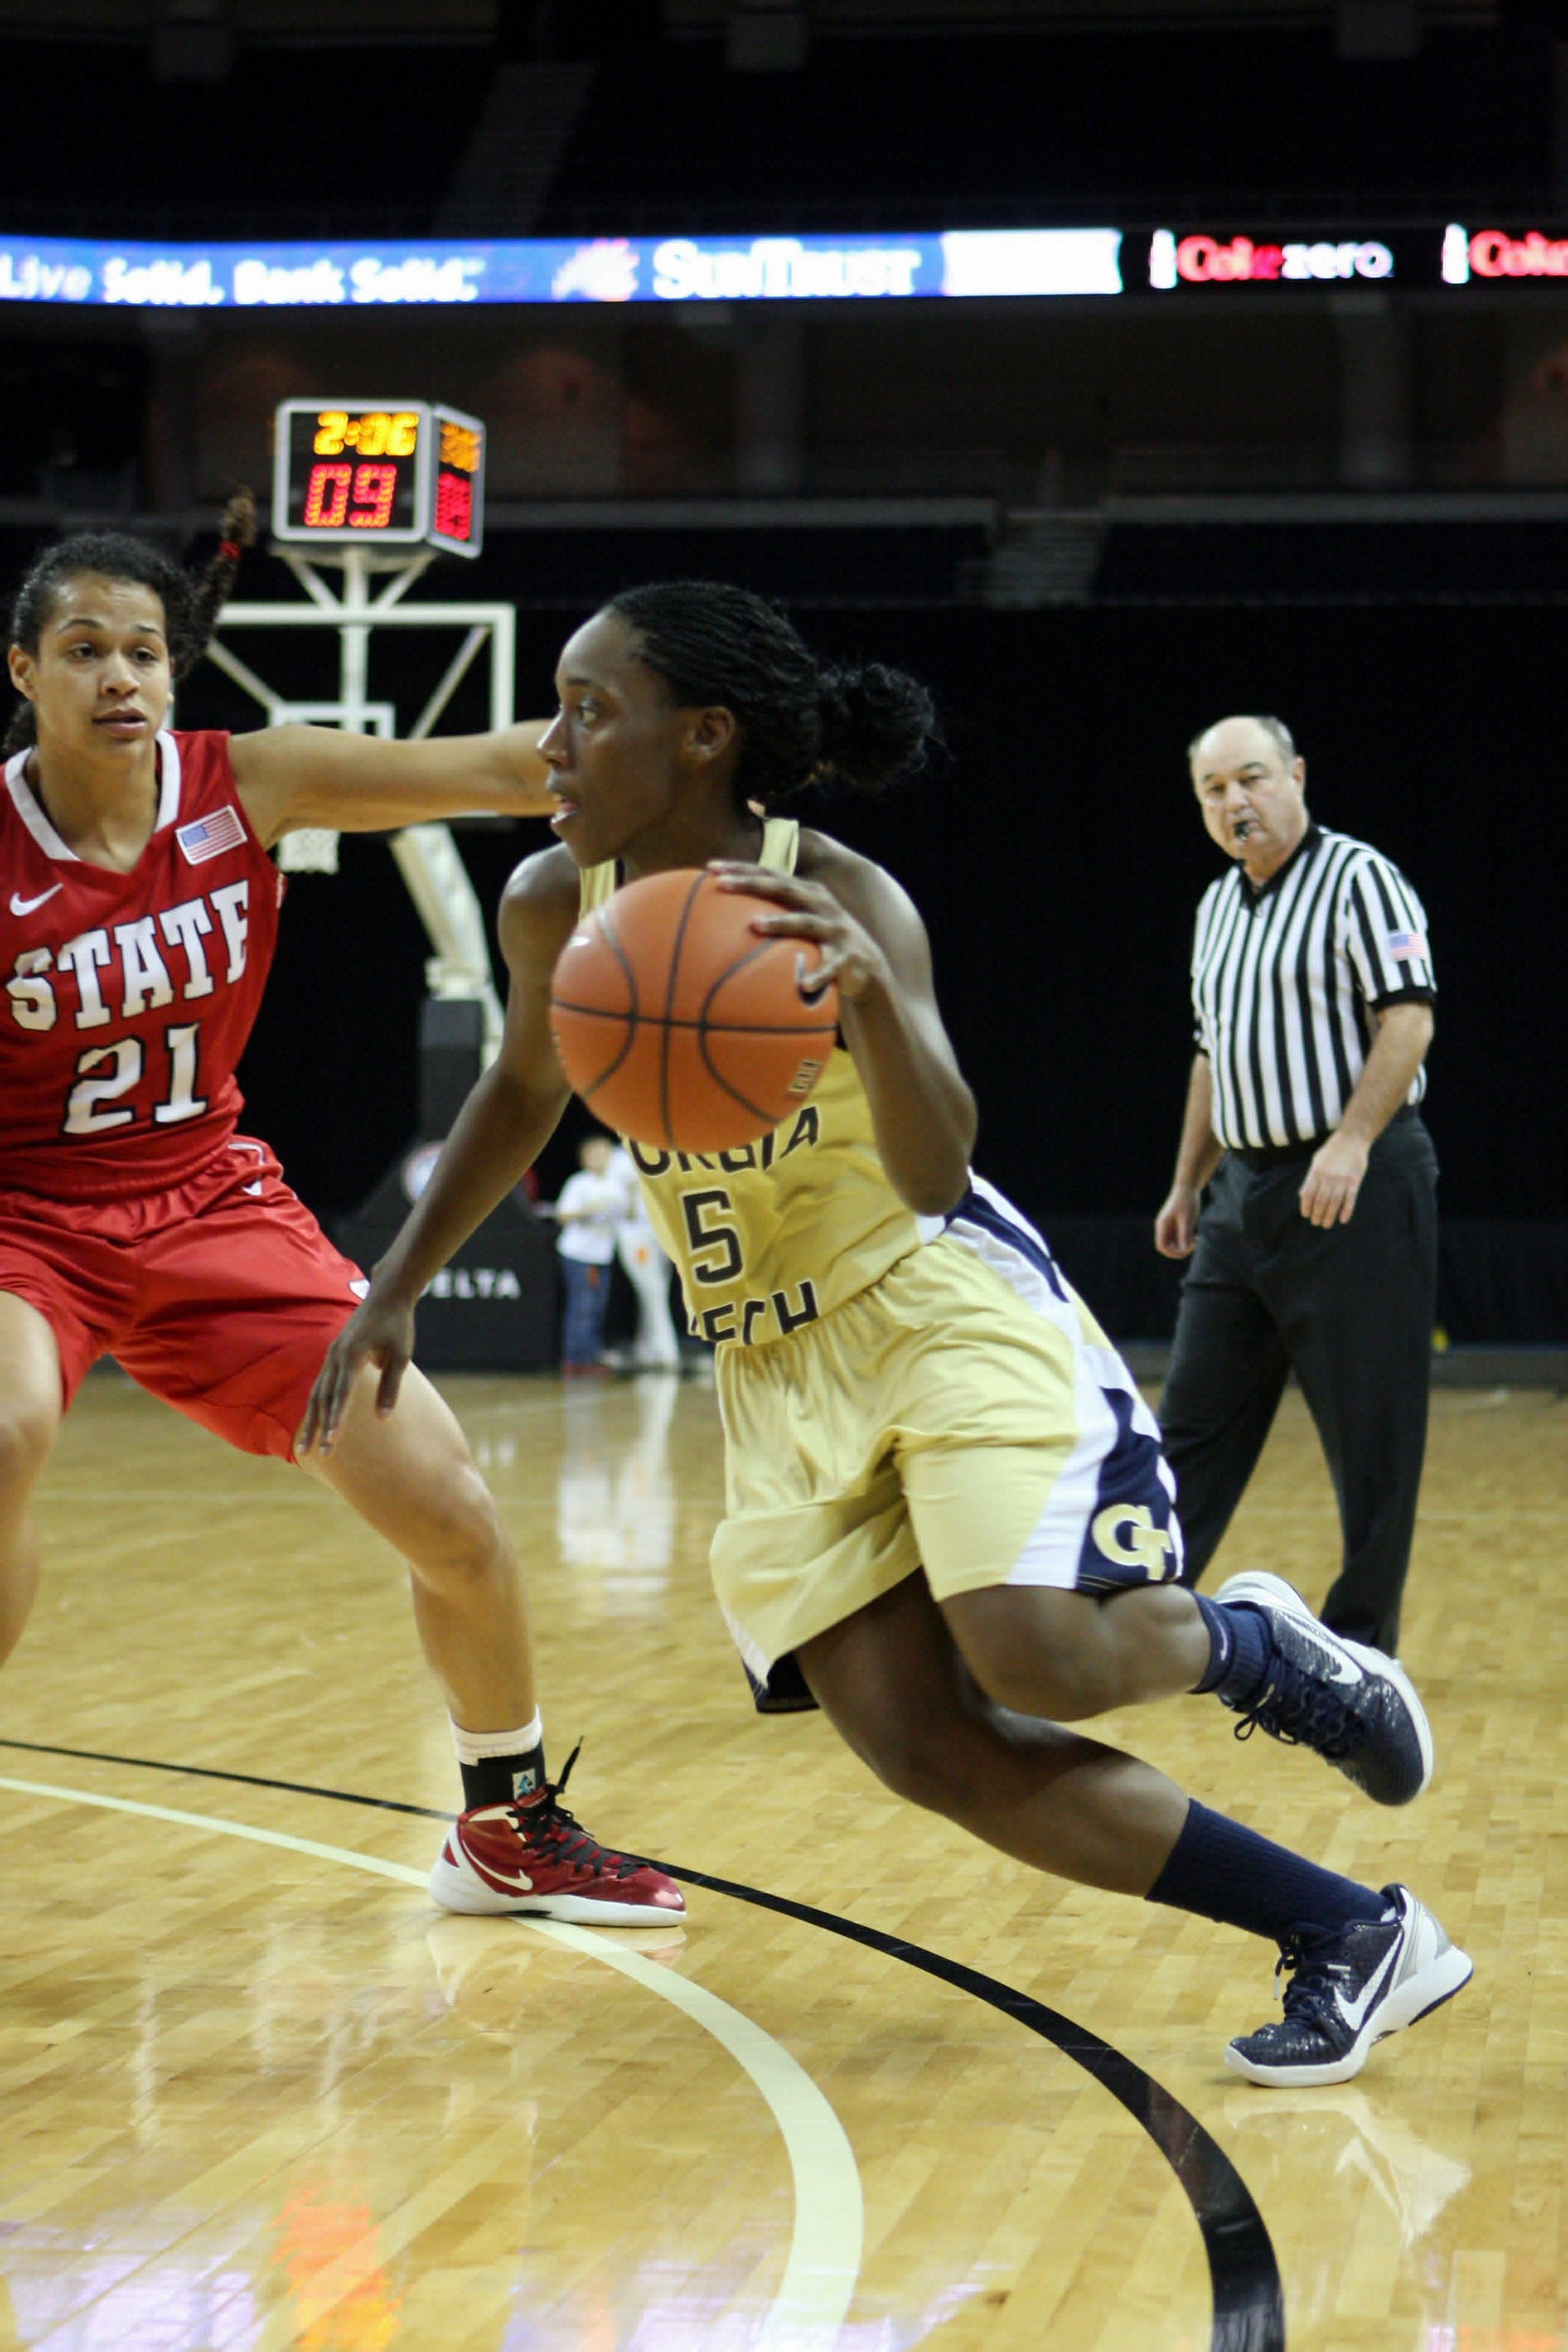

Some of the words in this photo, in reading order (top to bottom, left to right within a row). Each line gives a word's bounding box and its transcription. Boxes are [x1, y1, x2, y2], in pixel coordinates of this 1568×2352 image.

[0, 253, 92, 300] Live
[233, 259, 345, 305] Bank
[304, 463, 397, 528] 09
[6, 879, 249, 1032] STATE
[63, 1022, 207, 1135] 21
[679, 1187, 744, 1287] 5
[420, 1267, 521, 1299] ELTA
[690, 1280, 820, 1346] ECH
[1091, 1503, 1174, 1581] GT
